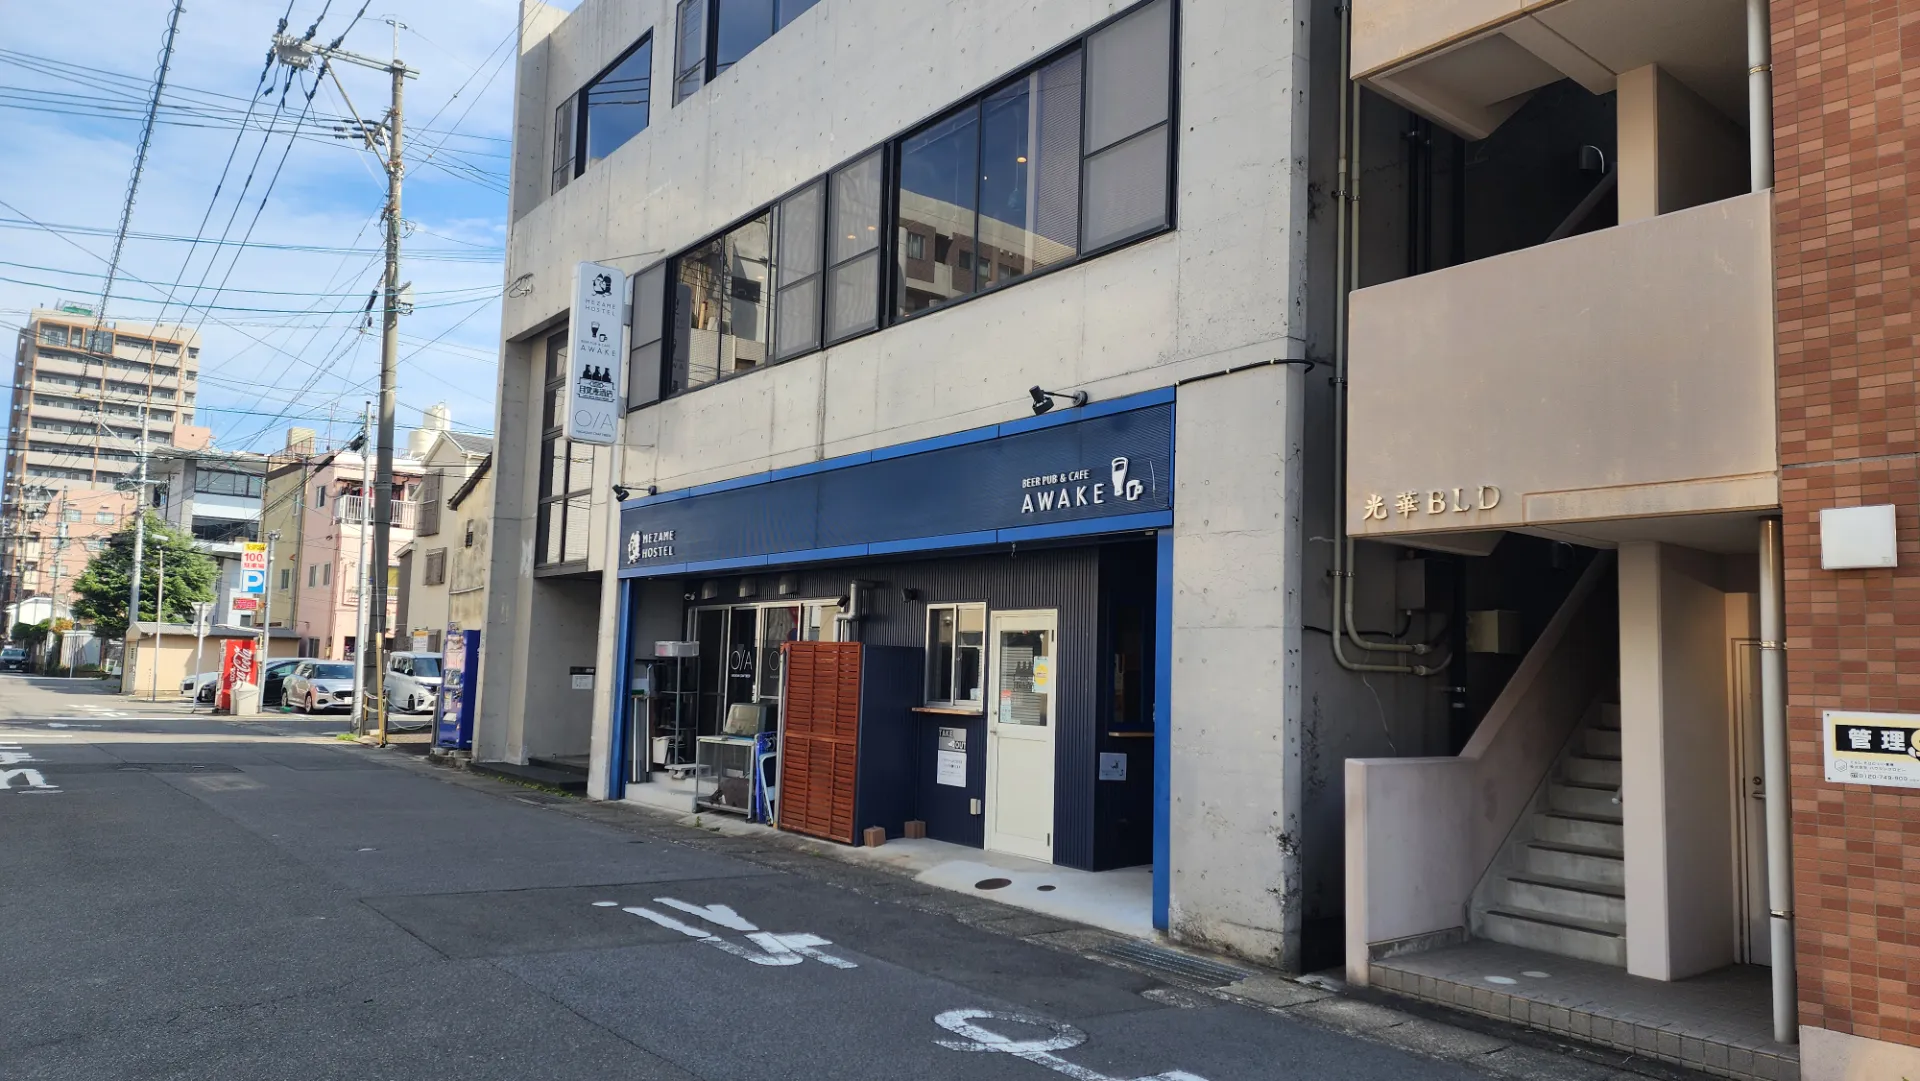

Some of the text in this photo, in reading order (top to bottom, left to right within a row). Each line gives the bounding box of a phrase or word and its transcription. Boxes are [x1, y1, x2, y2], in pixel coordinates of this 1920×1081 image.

[585, 304, 616, 317] HOSTEL
[580, 344, 617, 357] AWAKE
[1022, 468, 1090, 489] BEER PUB & CAFE
[1021, 483, 1106, 514] AWAKE
[642, 530, 675, 544] MEZAME
[641, 545, 674, 559] HOSTEL
[242, 571, 264, 592] P
[939, 729, 954, 738] TAKE
[1848, 728, 1907, 752] 管理
[954, 740, 967, 750] OUT
